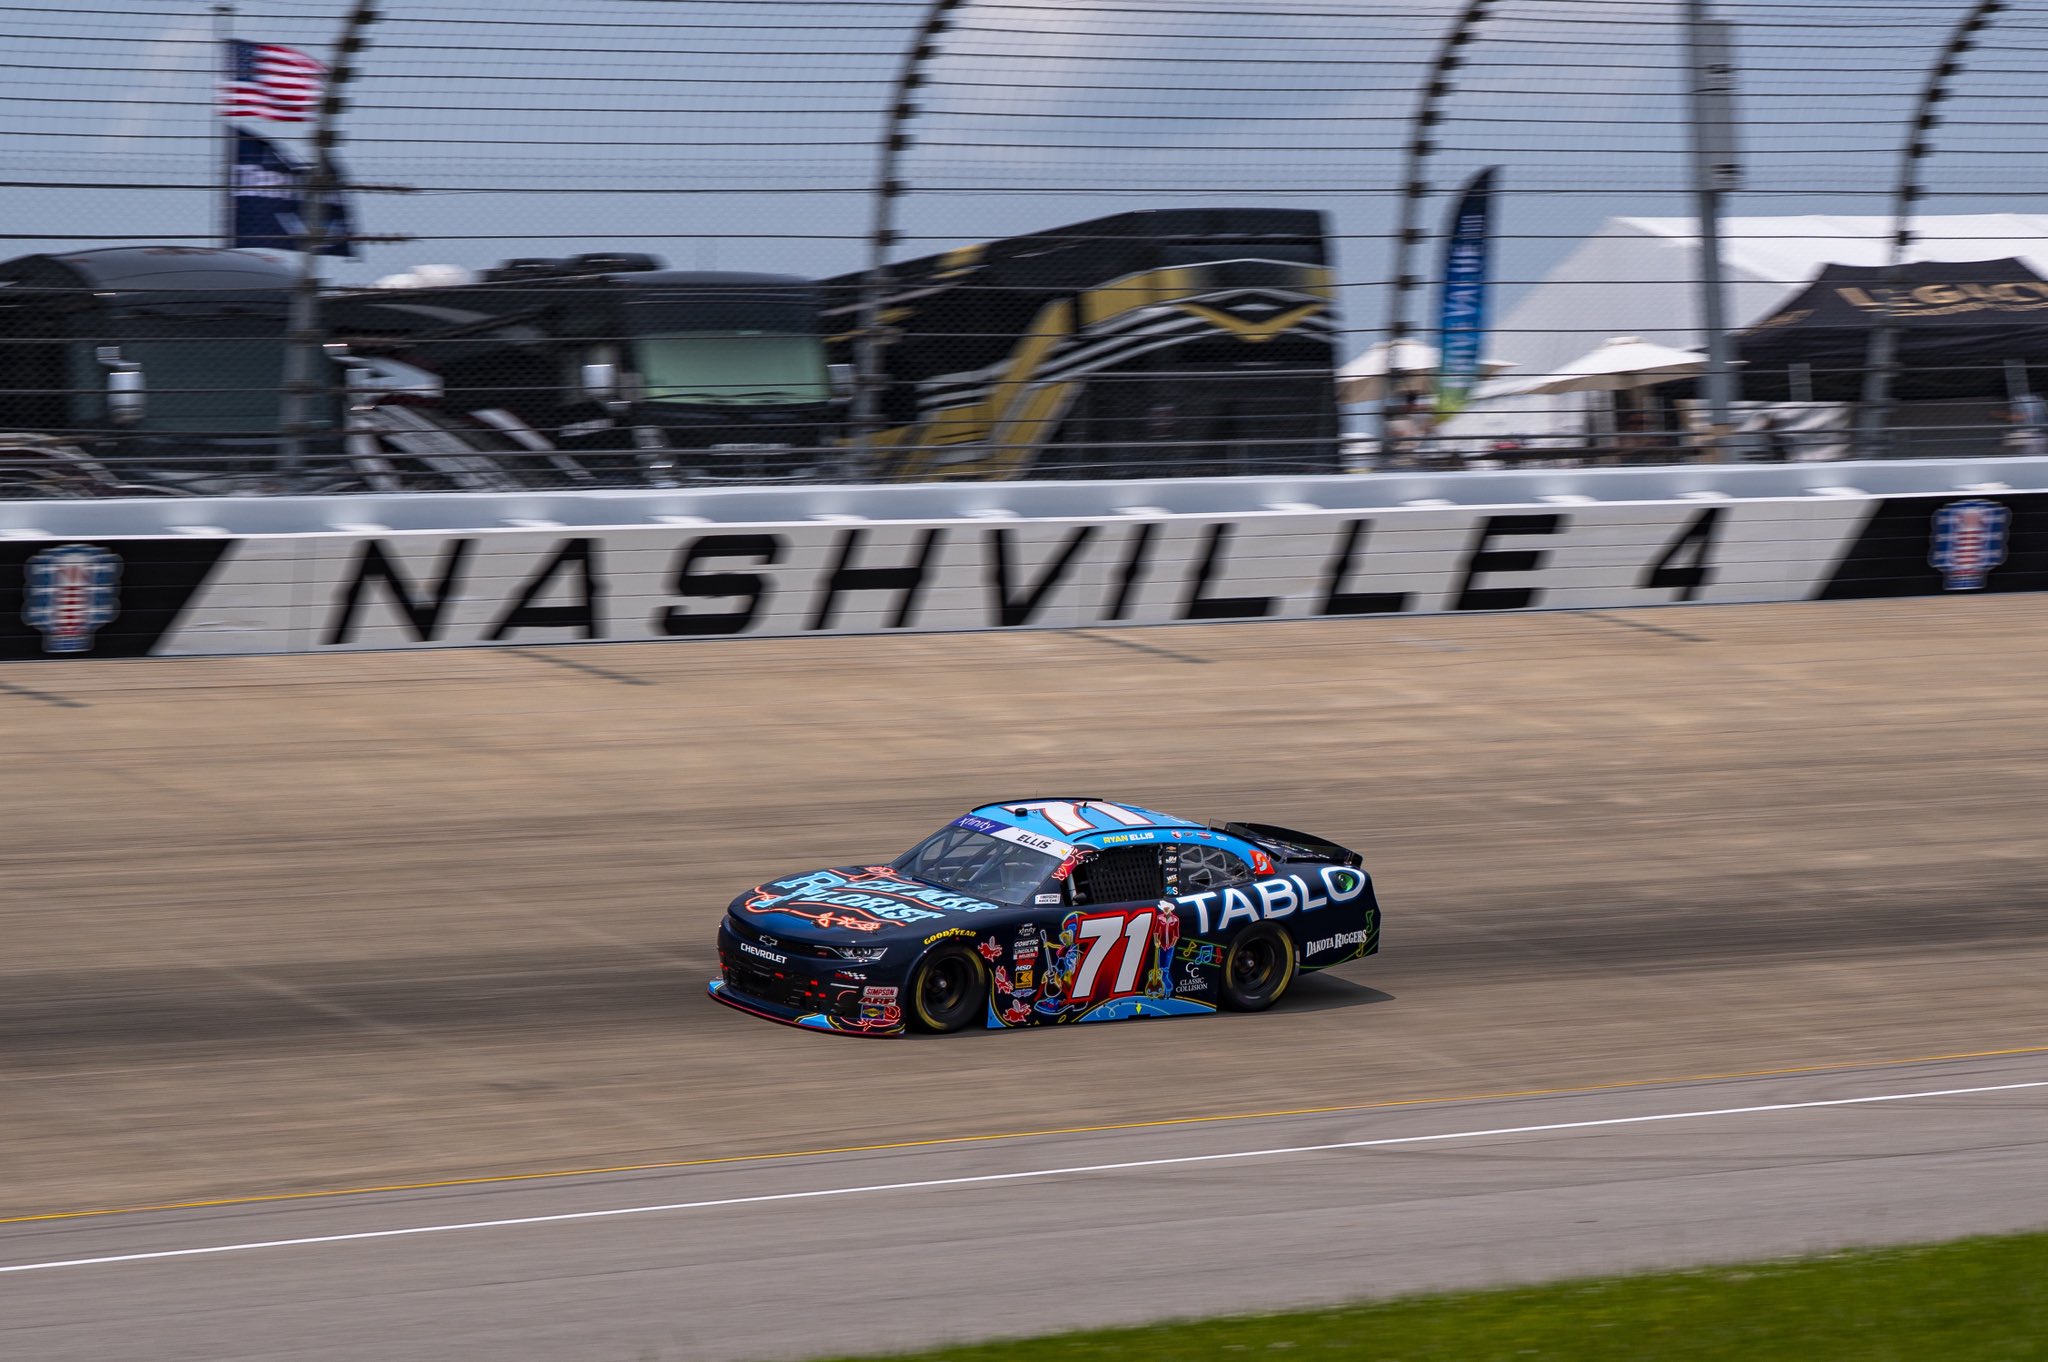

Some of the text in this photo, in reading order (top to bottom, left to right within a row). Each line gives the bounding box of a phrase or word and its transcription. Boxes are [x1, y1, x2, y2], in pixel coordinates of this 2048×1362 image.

[325, 507, 1727, 645] NASHVILLE 4
[958, 816, 996, 832] xfinity
[1016, 833, 1052, 850] ELLIS
[1103, 831, 1155, 845] RYAN ELLIS
[1176, 866, 1366, 934] TABLO
[923, 927, 977, 945] GOODYEAR
[1306, 929, 1368, 957] DAKOTA RIGGERS
[740, 942, 788, 964] CHEVROLET
[1070, 910, 1154, 1000] 71
[1175, 983, 1208, 993] COLLISION
[1180, 978, 1205, 986] CLASSIC
[865, 987, 896, 997] SIMPSON
[860, 997, 895, 1005] ARP
